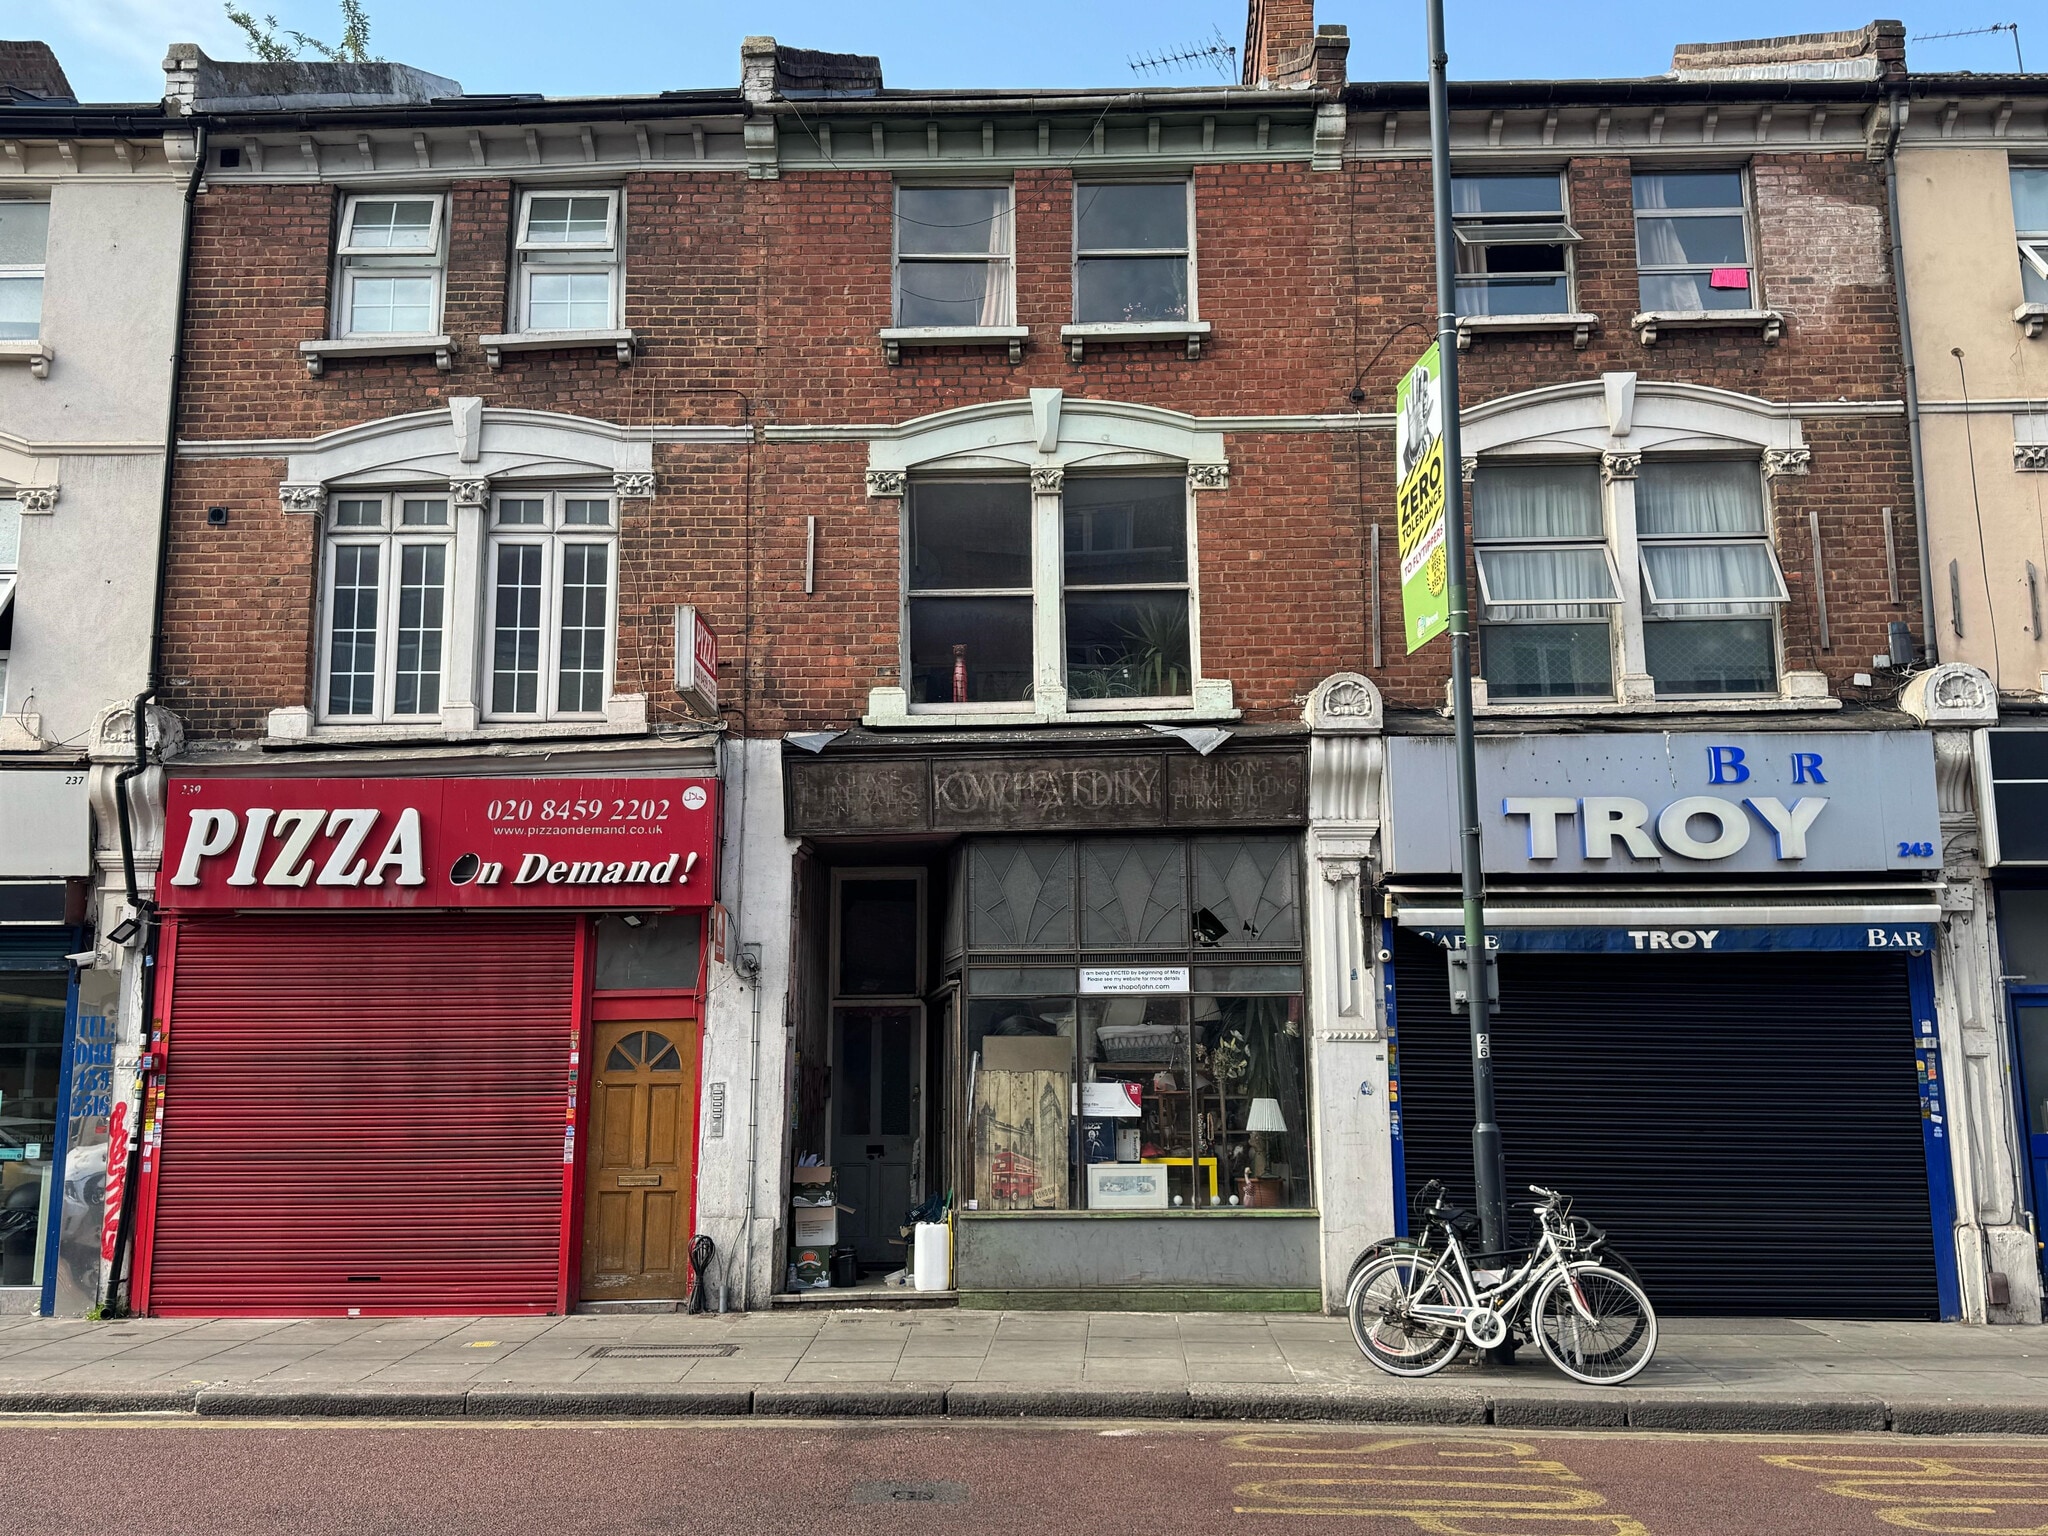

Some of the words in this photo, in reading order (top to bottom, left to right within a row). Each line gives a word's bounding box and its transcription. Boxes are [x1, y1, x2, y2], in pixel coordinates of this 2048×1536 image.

[1401, 457, 1440, 527] ZERO
[1402, 485, 1441, 541] TOLERANCE
[1405, 562, 1412, 576] TO
[696, 619, 716, 676] PIZZA
[65, 776, 84, 785] 237
[181, 784, 201, 795] 239
[487, 799, 533, 821] 020
[540, 799, 603, 821] 8459
[609, 799, 670, 821] 2202
[493, 825, 663, 837] www.pizzaondemand.co.uk
[1503, 796, 1830, 860] TROY
[170, 807, 426, 887] PIZZA
[1897, 841, 1934, 858] 243
[511, 852, 698, 885] Demand!
[1628, 930, 1720, 949] TROY
[1867, 928, 1923, 948] BAR
[1103, 983, 1170, 991] www.shopofjohn.com
[1035, 1186, 1056, 1200] LONDON
[1220, 1431, 1654, 1536] STOP
